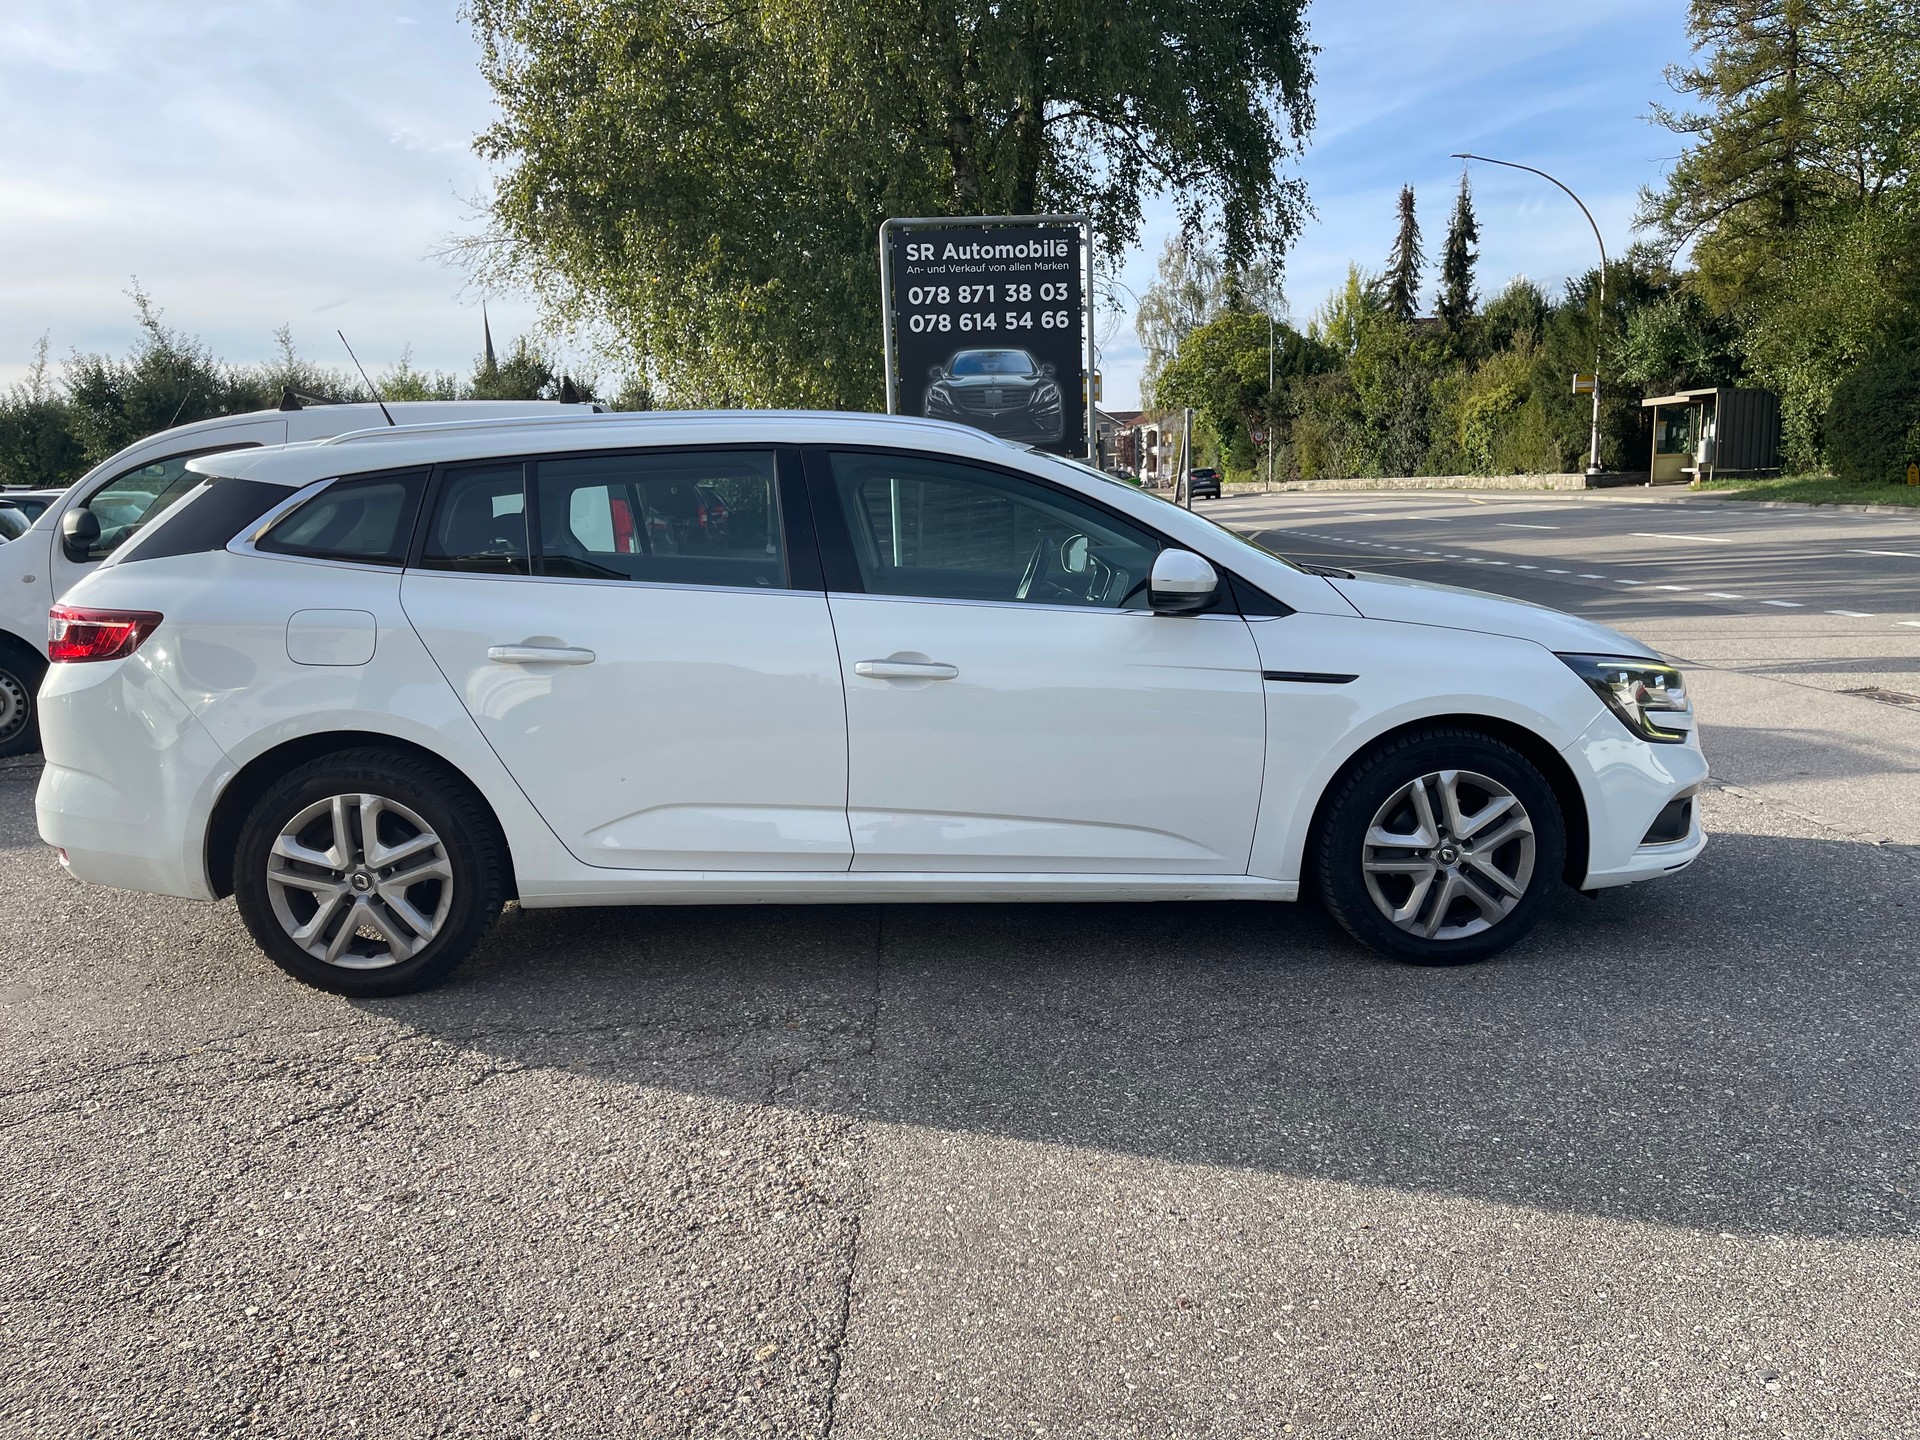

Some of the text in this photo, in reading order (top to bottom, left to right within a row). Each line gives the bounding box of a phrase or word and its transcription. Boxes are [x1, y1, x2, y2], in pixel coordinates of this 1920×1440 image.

[906, 239, 1069, 262] SR Automobile
[906, 261, 1070, 274] An- und Verkauf von allen Marken
[908, 282, 1069, 306] 078 871 38 03
[909, 311, 1070, 333] 078 614 54 66
